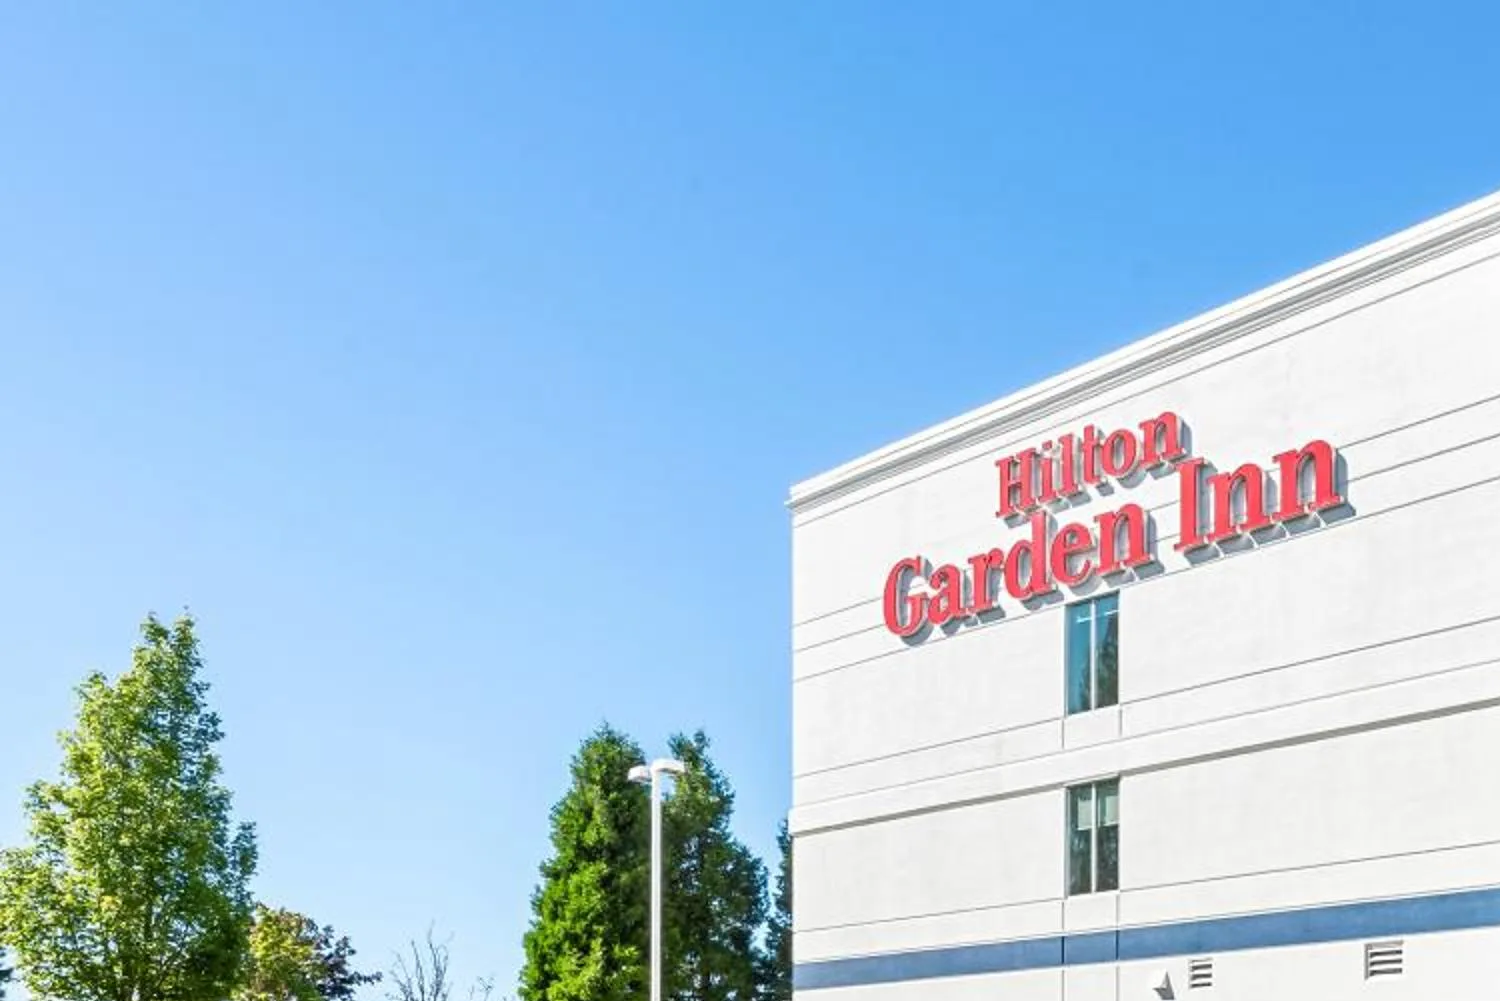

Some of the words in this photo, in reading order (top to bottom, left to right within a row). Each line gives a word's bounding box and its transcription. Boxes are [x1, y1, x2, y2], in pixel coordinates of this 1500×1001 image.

[883, 503, 1153, 637] Garden
[1174, 439, 1345, 551] Inn
[995, 411, 1185, 518] Hilton
